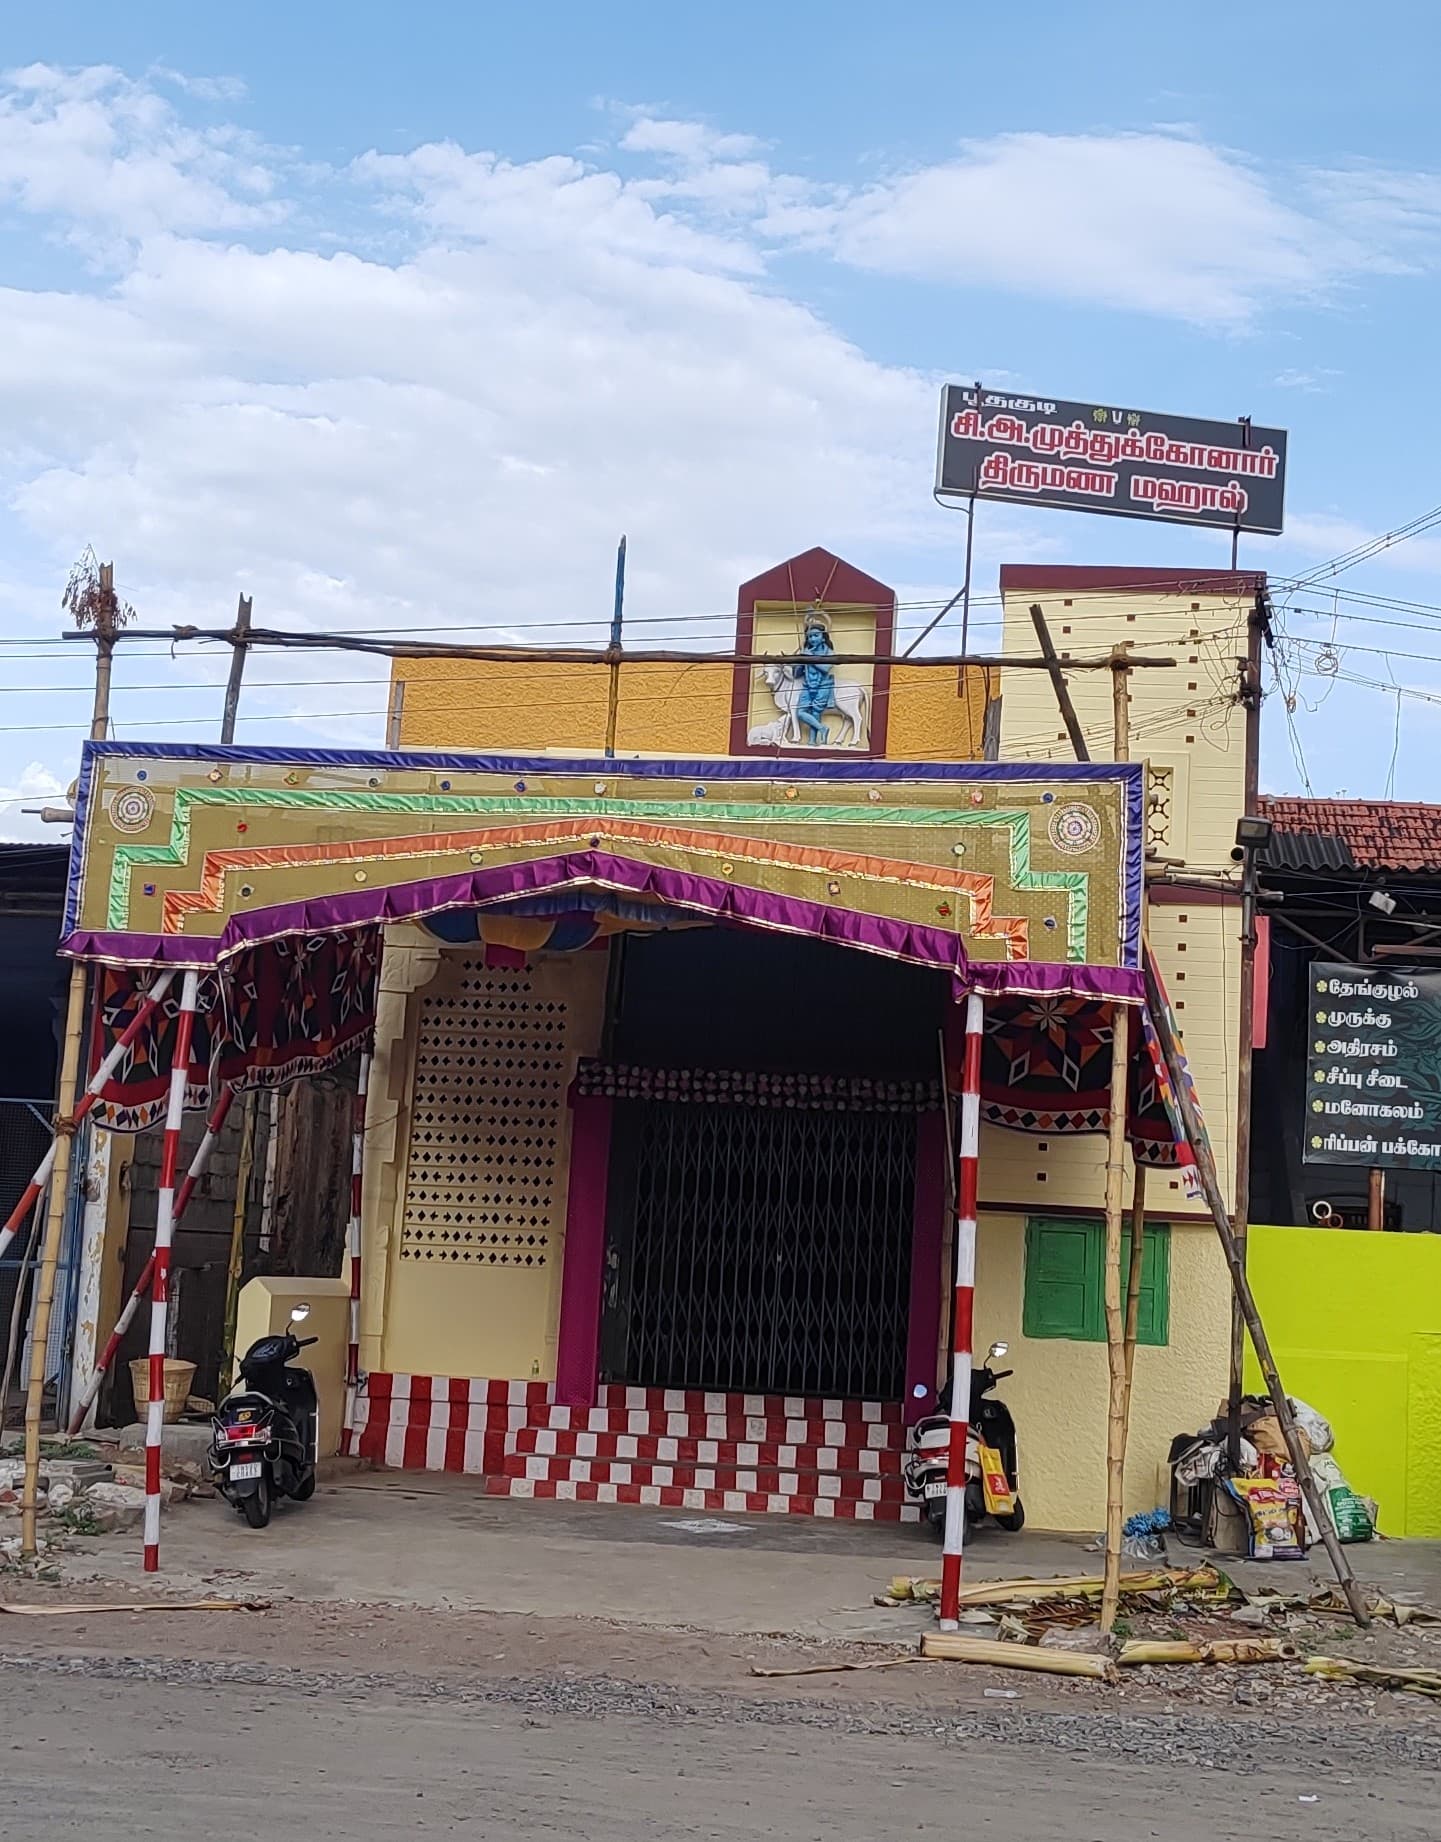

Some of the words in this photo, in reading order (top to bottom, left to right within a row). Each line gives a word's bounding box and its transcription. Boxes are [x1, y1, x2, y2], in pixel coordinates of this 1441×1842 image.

[979, 453, 1119, 497] திருமண
[1131, 475, 1248, 514] மஹால்
[1329, 978, 1419, 1001] தேங்குழல்
[1328, 1007, 1392, 1028] முருக்கு
[1327, 1037, 1398, 1057] அதிரசம்
[1326, 1066, 1362, 1089] சீப்பு
[1366, 1068, 1409, 1089] சீடை
[1324, 1099, 1424, 1118] மனோகலம்
[1323, 1133, 1378, 1153] ரிப்பன்
